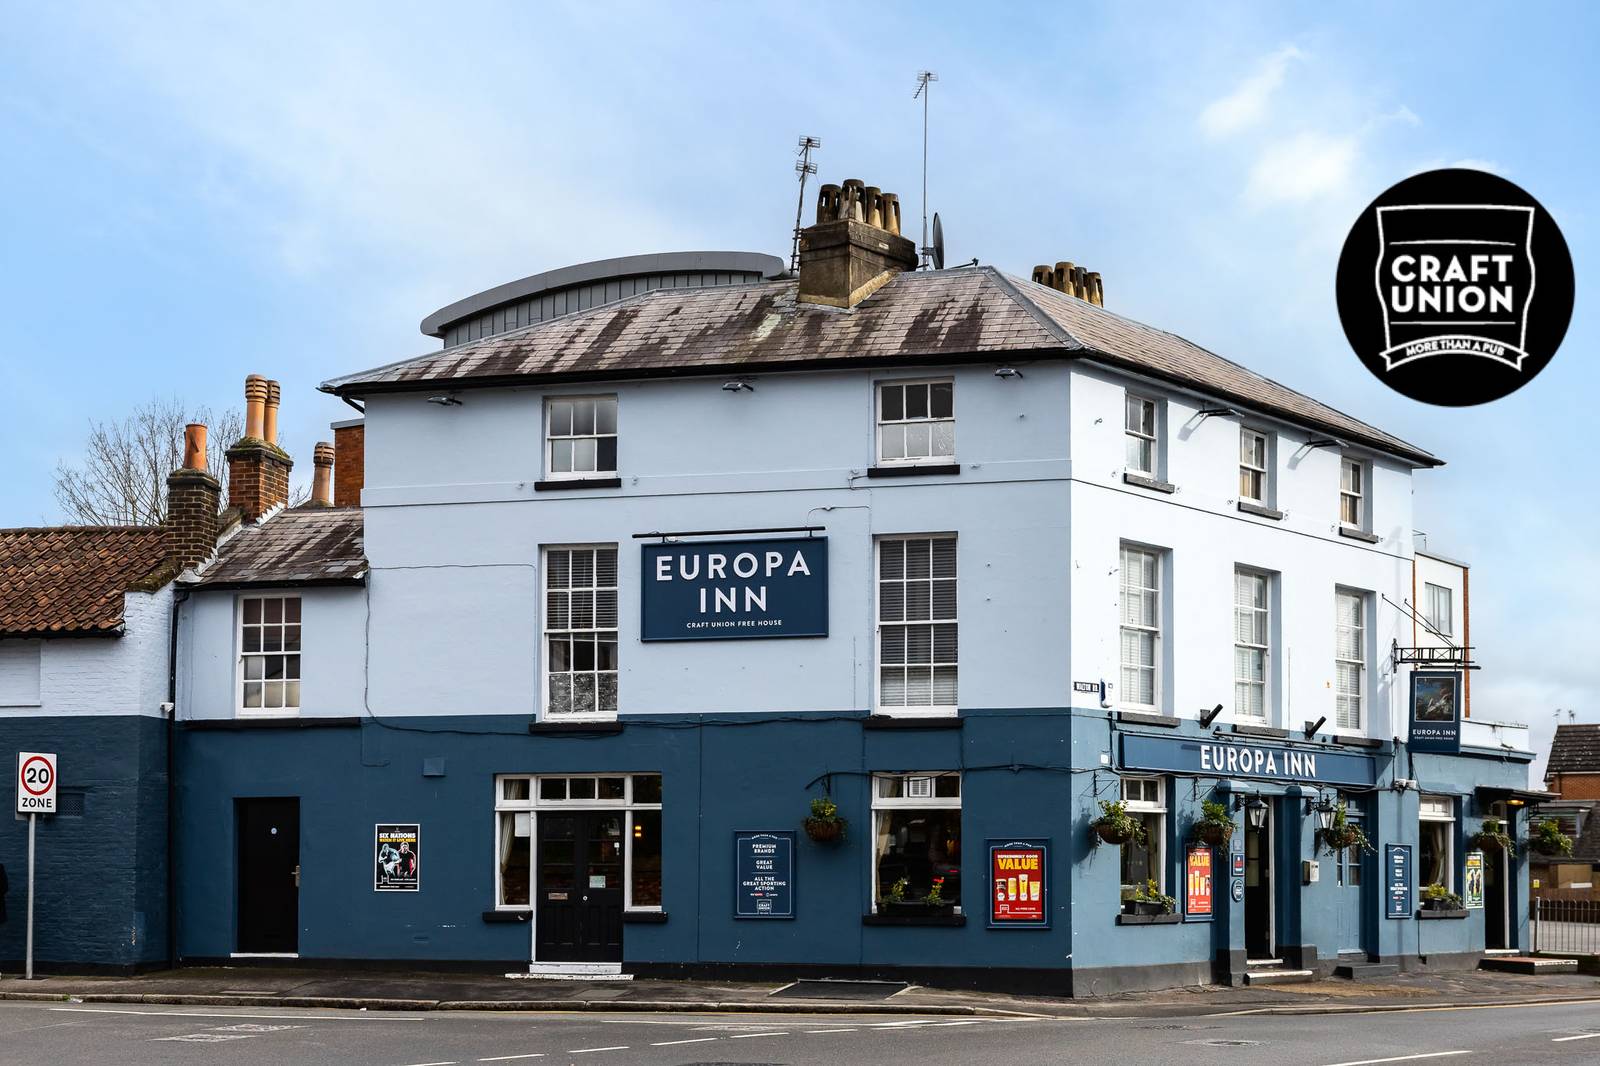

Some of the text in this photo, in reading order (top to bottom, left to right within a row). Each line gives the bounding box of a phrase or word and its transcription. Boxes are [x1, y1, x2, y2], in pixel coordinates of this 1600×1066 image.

[656, 550, 811, 581] EUROPA
[700, 586, 767, 613] INN
[686, 621, 709, 629] CRAFT
[711, 620, 736, 628] UNION
[757, 619, 782, 627] HOUSE
[1200, 745, 1316, 778] EUROPA INN
[26, 767, 49, 784] 20
[22, 797, 52, 808] ZONE
[997, 858, 1039, 870] VALUE
[1189, 855, 1210, 867] VALUE
